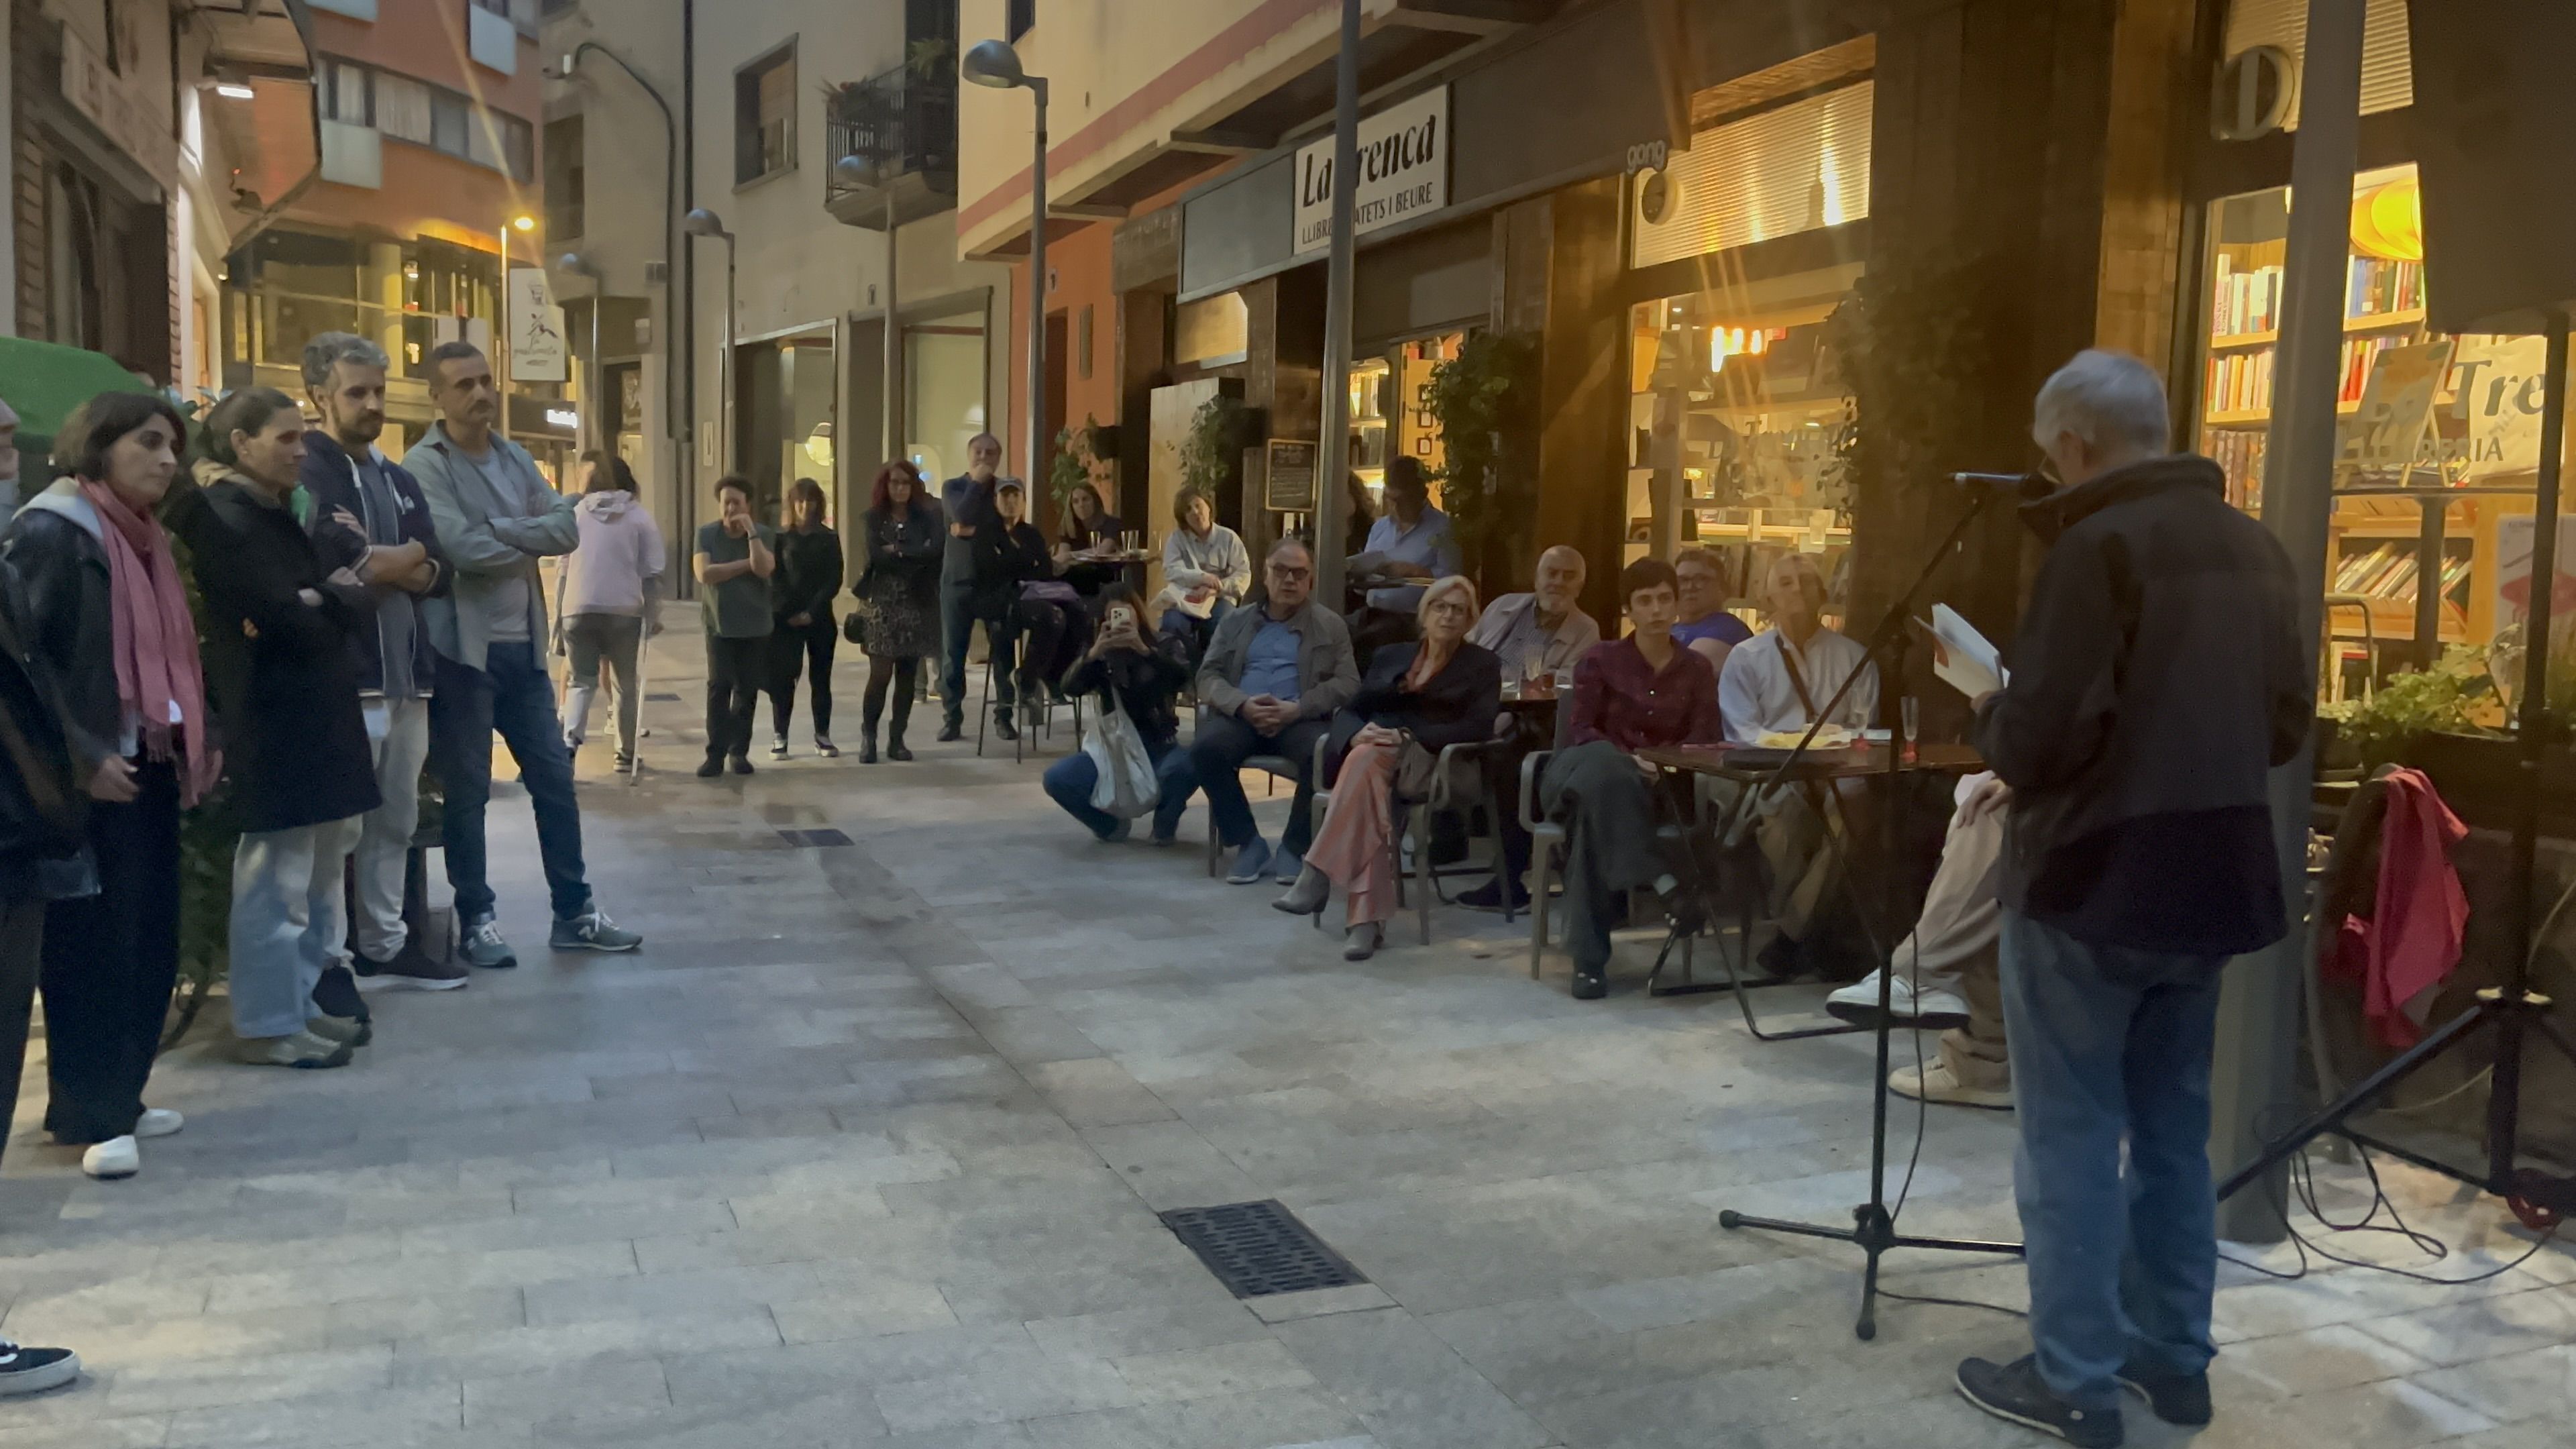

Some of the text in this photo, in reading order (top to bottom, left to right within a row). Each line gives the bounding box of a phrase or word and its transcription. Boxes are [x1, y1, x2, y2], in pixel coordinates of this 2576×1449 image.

[1303, 114, 1436, 208] La renca
[1302, 182, 1433, 245] LLIBRE ATETS I BEURE
